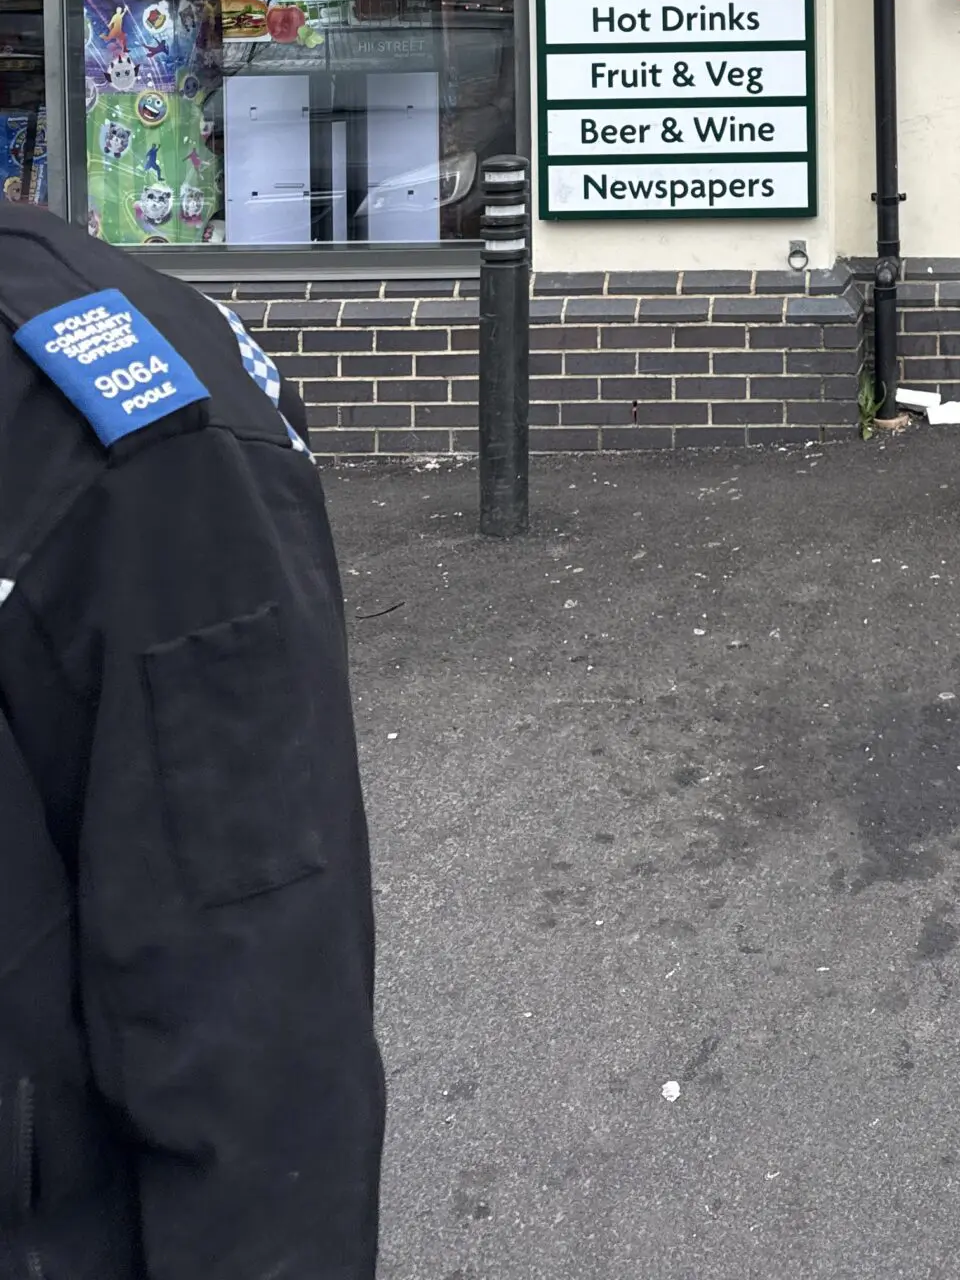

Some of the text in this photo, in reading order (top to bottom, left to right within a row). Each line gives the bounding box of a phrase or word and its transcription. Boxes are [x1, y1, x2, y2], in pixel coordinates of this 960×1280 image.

[592, 2, 761, 33] Hot Drinks
[590, 60, 764, 95] Fruit & Veg
[580, 116, 776, 144] Beer & Wine
[582, 173, 775, 207] Newspapers
[45, 311, 132, 353] COMMUNITY
[53, 306, 110, 336] POLICE
[63, 324, 132, 358] SUPPORT
[77, 334, 139, 365] OFFICER
[94, 355, 169, 399] 9064
[121, 381, 177, 415] POOLE
